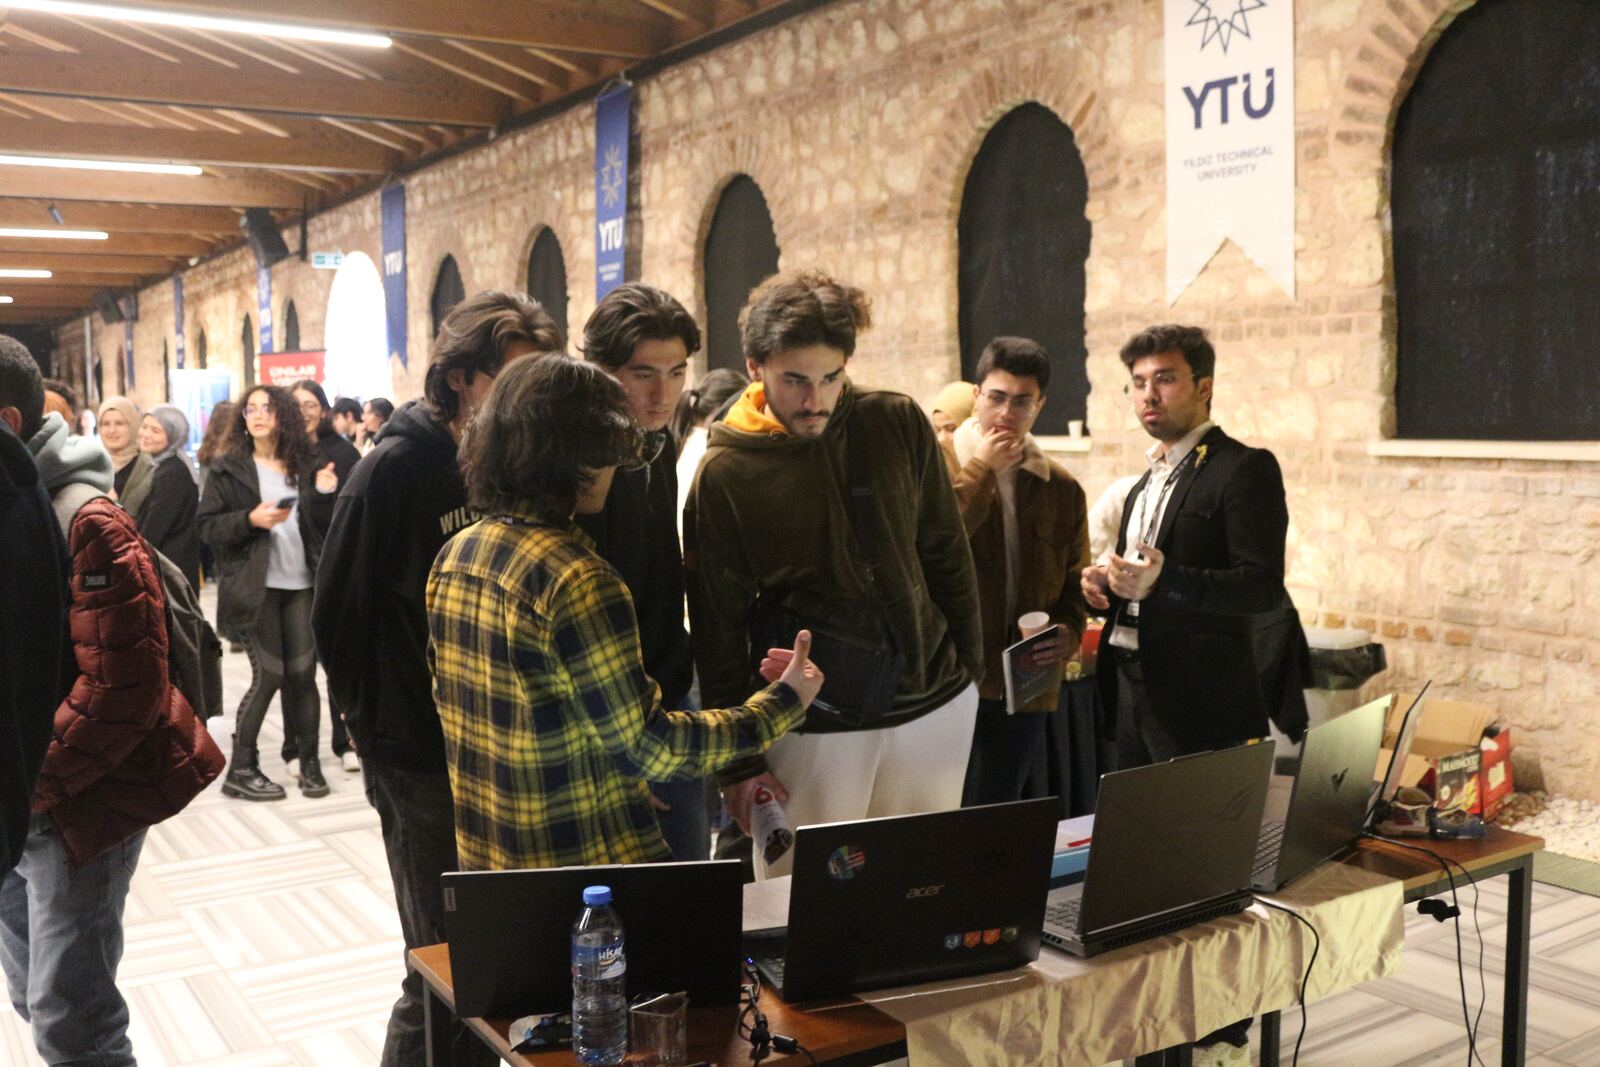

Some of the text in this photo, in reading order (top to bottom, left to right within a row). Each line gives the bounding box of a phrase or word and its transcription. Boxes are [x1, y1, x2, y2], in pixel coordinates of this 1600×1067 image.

[1216, 145, 1275, 163] TECHNICAL
[1197, 162, 1258, 181] UNIVERSITY
[905, 884, 946, 899] acer
